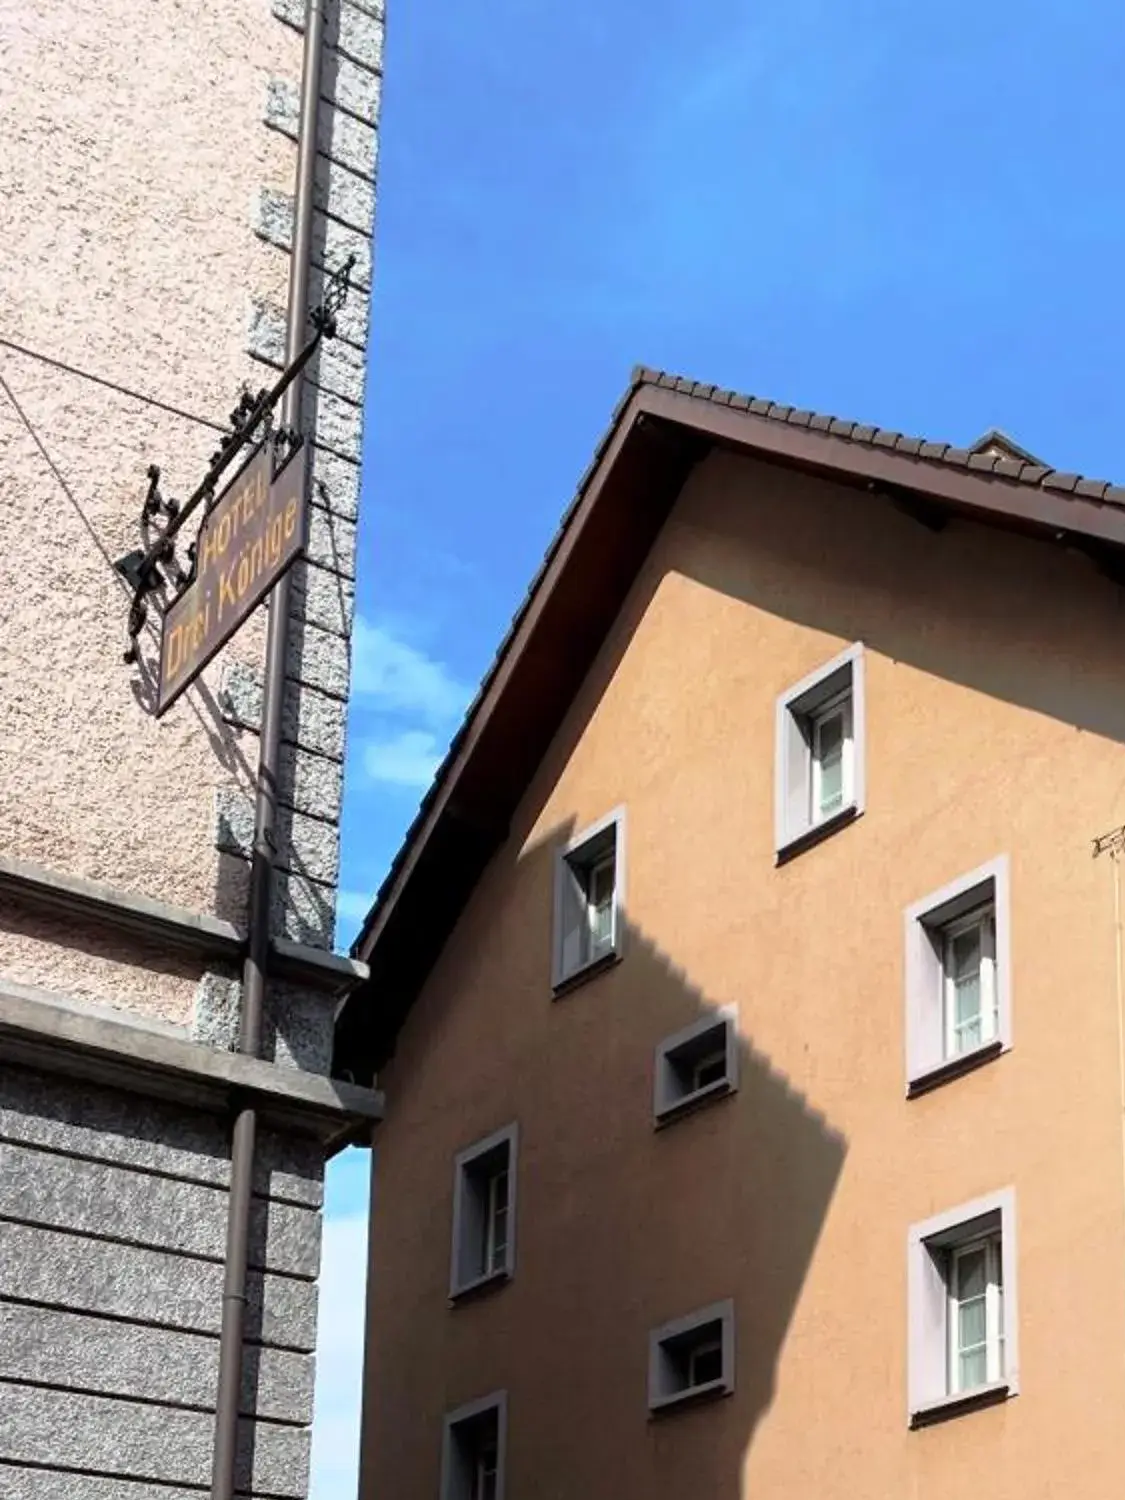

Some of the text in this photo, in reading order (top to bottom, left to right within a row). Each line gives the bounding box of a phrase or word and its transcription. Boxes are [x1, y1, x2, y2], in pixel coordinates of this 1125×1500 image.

[166, 496, 297, 680] Drei Könige
[203, 470, 268, 574] HOTEL
